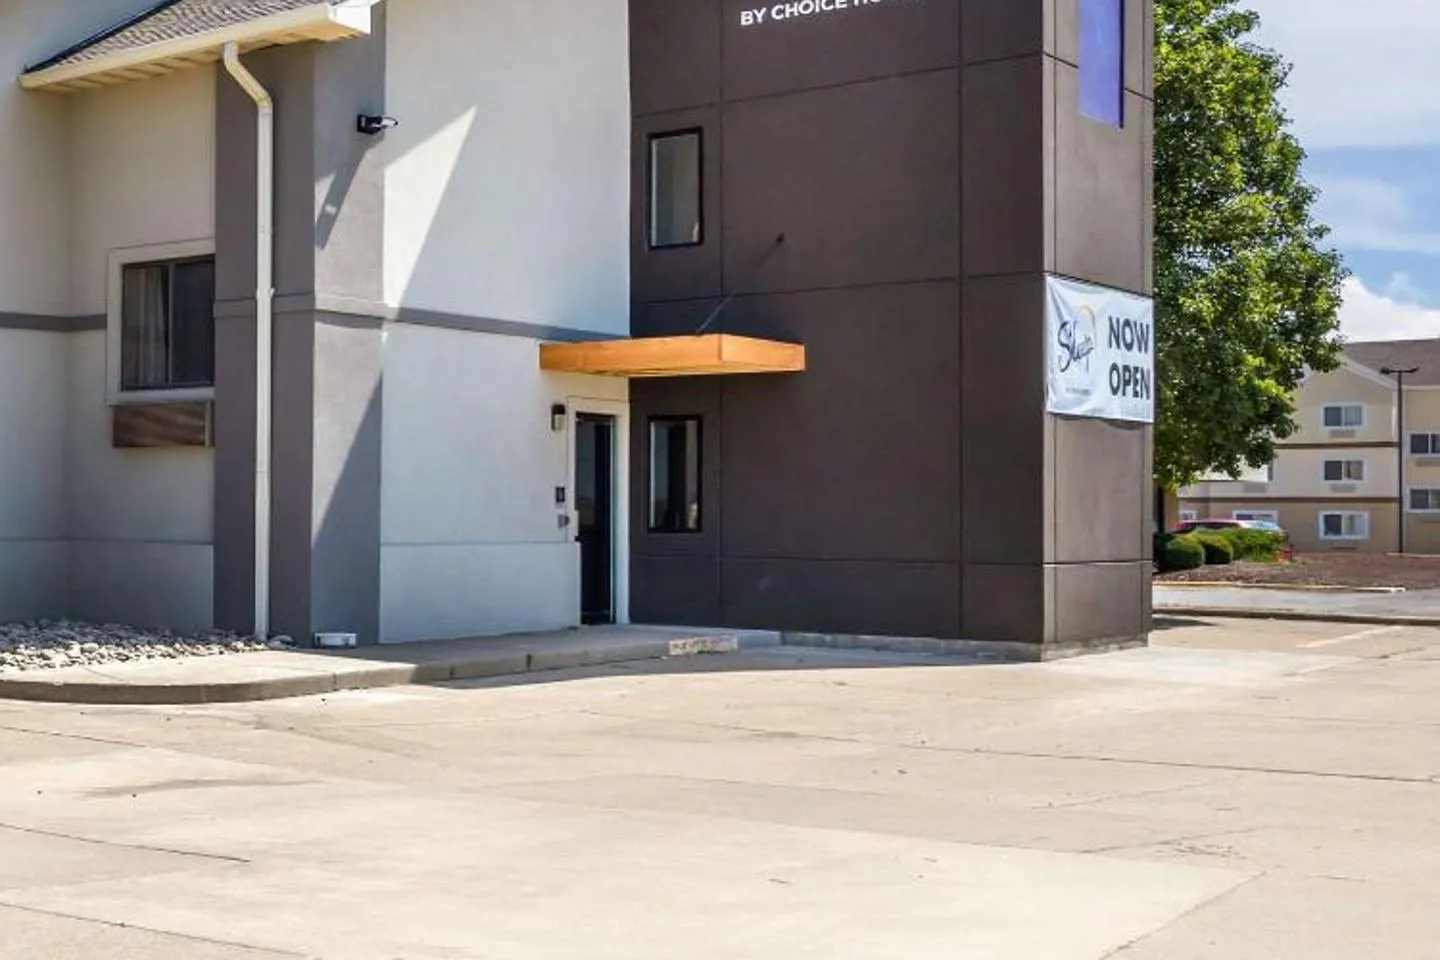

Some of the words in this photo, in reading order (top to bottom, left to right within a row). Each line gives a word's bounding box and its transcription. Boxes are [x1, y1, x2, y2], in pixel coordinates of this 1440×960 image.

[739, 8, 766, 26] BY
[1109, 316, 1150, 354] NOW
[1110, 362, 1151, 401] OPEN
